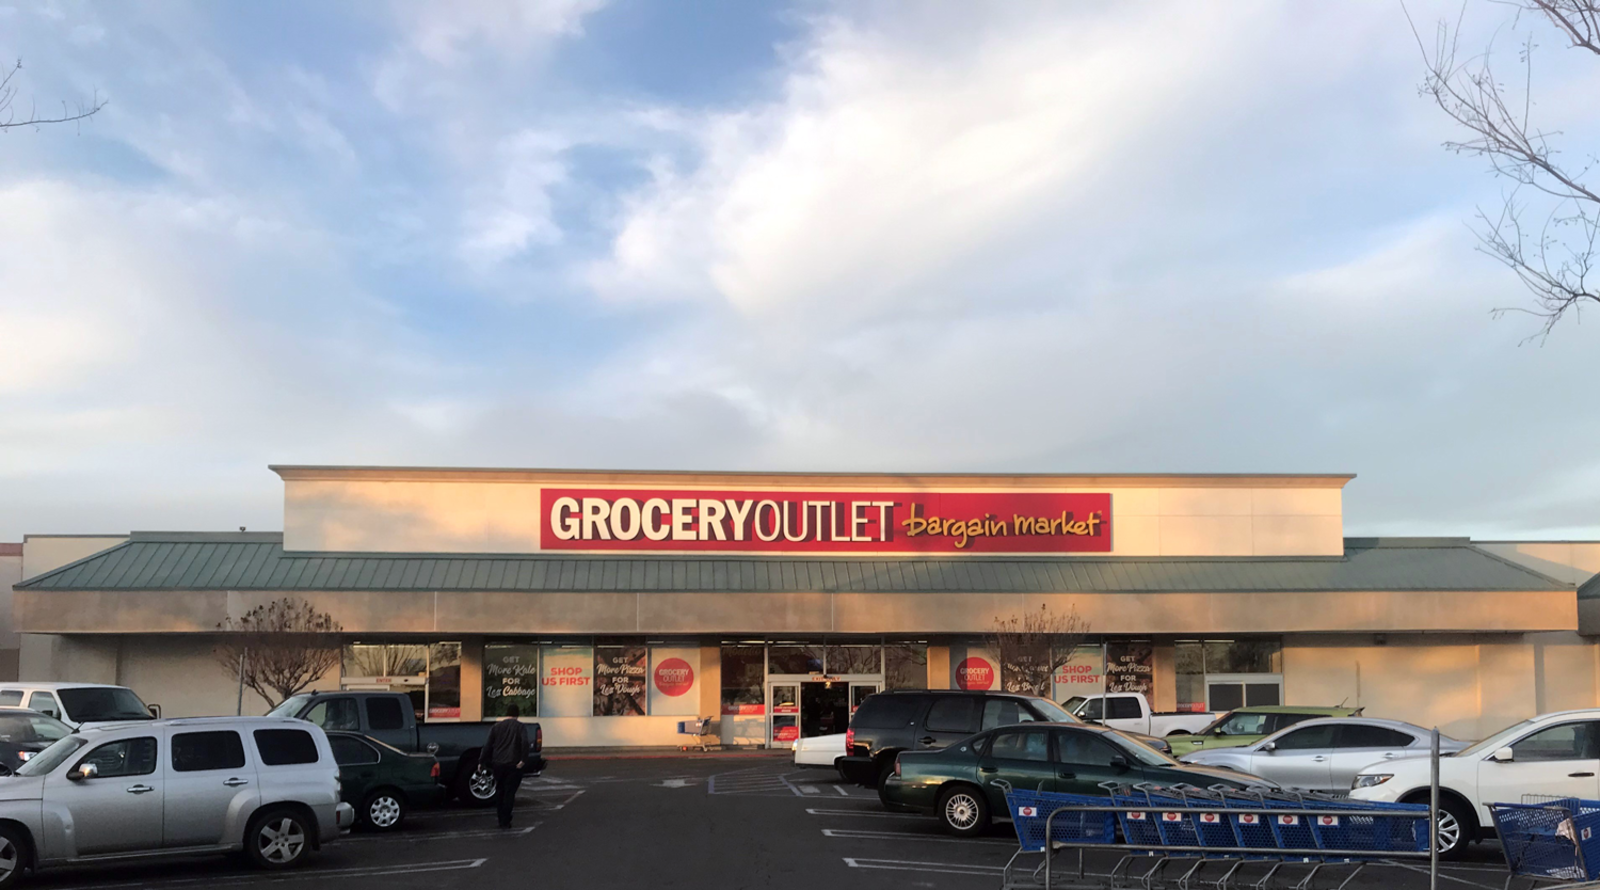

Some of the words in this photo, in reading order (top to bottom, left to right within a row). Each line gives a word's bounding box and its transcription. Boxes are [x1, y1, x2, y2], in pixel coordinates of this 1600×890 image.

[901, 503, 1008, 548] bargain
[1013, 511, 1101, 536] market
[502, 656, 520, 664] GET
[1120, 655, 1136, 663] GET
[487, 663, 511, 676] More
[512, 664, 536, 677] Kale
[550, 667, 583, 676] SHOP
[596, 663, 619, 676] More
[619, 663, 645, 675] Pizza
[658, 668, 690, 676] GROCERY
[959, 667, 990, 675] GROCERY
[1061, 665, 1093, 674] SHOP
[1106, 662, 1127, 674] More
[1127, 662, 1151, 673] Pizza
[502, 677, 521, 685] FOR
[541, 677, 557, 686] US
[559, 676, 591, 686] FIRST
[612, 676, 629, 684] FOR
[662, 675, 685, 683] OUTLET
[1054, 674, 1069, 684] US
[1070, 674, 1100, 684] FIRST
[1120, 674, 1137, 682] FOR
[502, 685, 535, 699] Cabbage
[614, 682, 641, 696] Dough
[1123, 681, 1147, 694] Dough
